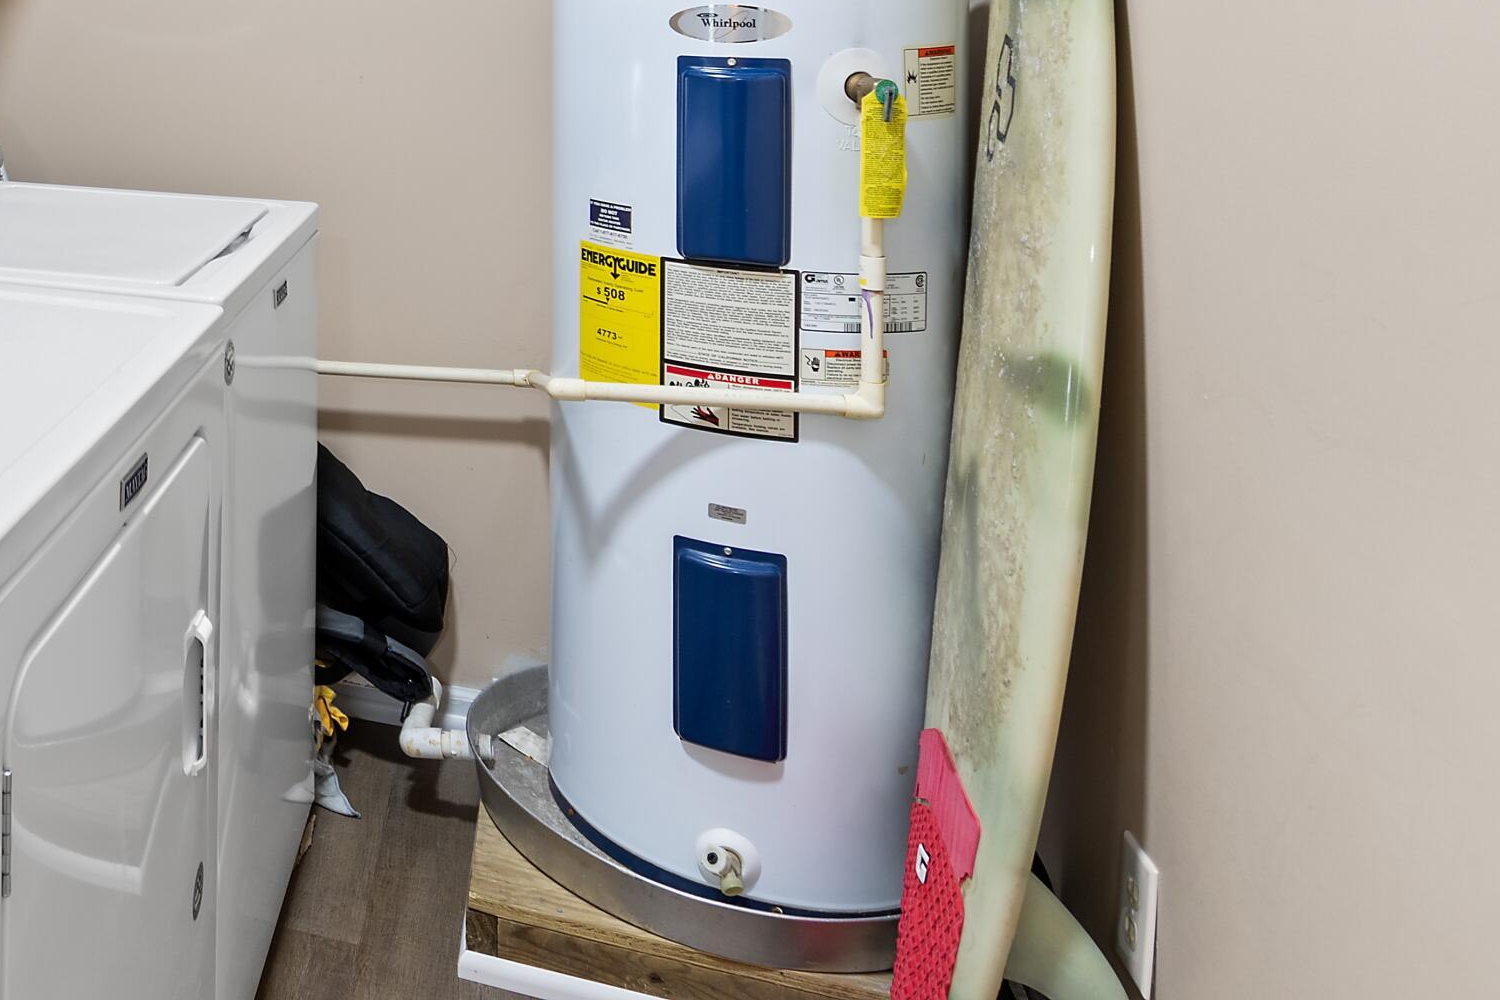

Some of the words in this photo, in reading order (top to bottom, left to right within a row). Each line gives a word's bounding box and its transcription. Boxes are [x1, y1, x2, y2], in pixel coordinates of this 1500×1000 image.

[701, 18, 756, 30] Whirlpool
[581, 247, 656, 276] ENERGYGUIDE
[604, 286, 625, 300] 508
[597, 328, 617, 340] 4773
[715, 373, 759, 385] DANGER
